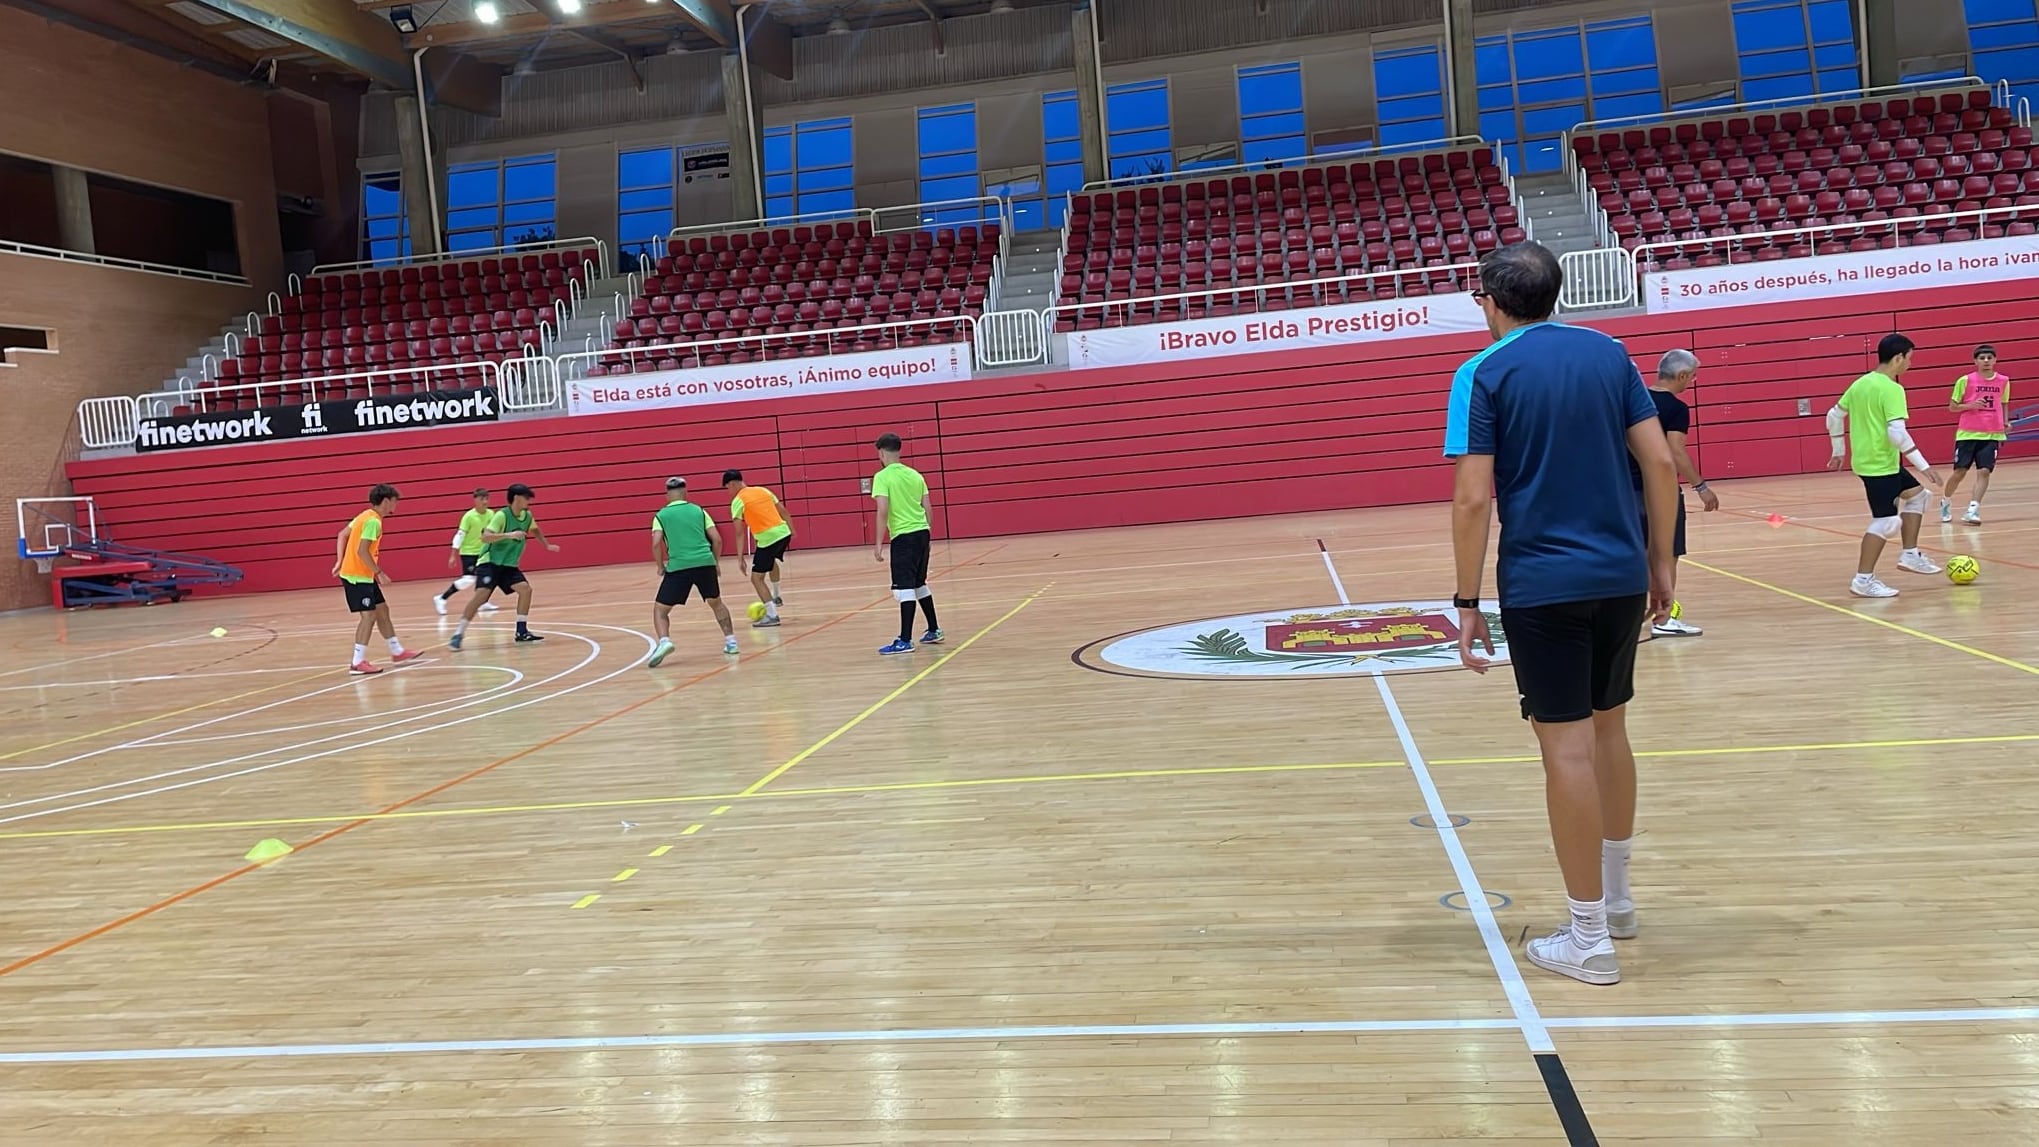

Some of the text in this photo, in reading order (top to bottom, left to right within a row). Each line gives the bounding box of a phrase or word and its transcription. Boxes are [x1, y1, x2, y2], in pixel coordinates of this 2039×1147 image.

[1680, 283, 1703, 297] 30
[1708, 279, 1749, 295] años
[1754, 270, 1832, 290] después,
[1837, 268, 1859, 282] ha
[1864, 260, 1932, 281] llegado
[1937, 258, 1953, 272] la
[1958, 255, 1999, 271] hora
[1159, 306, 1429, 351] ¡Bravo Elda Prestigio!
[592, 357, 936, 404] Elda está con vosotras, ¡Ánimo equipo!
[301, 403, 322, 428] fi
[354, 390, 494, 427] finetwork
[138, 410, 273, 447] finetwork
[300, 425, 328, 434] network
